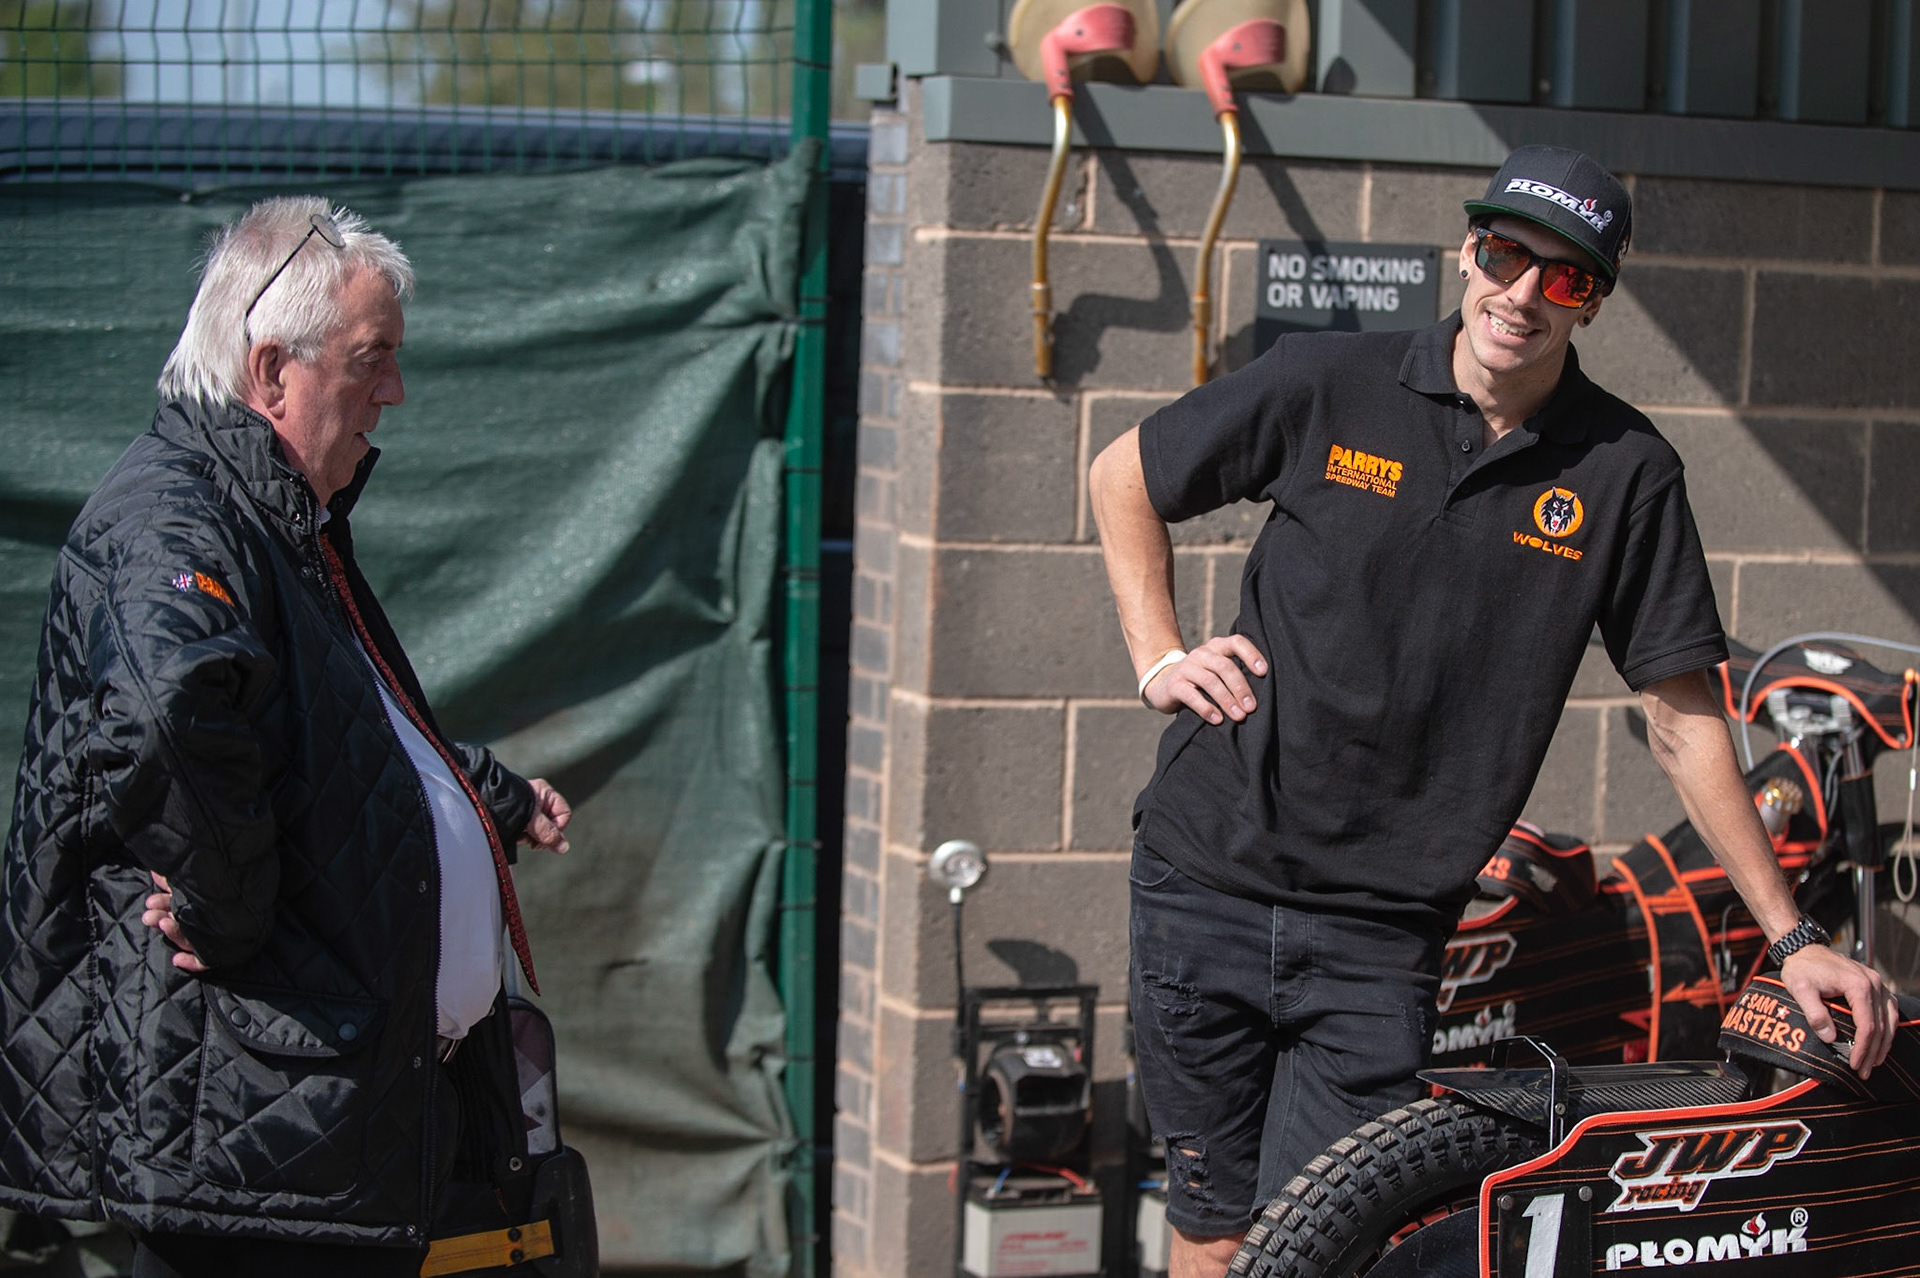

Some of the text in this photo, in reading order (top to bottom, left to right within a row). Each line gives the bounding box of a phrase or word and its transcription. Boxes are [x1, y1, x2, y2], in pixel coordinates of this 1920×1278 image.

[1268, 253, 1425, 284] NO SMOKING
[1267, 282, 1399, 312] OR VAPING
[1326, 464, 1397, 490] INTERNATIONAL
[1328, 444, 1403, 482] PARRYS
[1325, 472, 1396, 498] SPEEDWAY TEAM
[1513, 531, 1583, 561] WOLVES
[1747, 992, 1778, 1014] SAM
[1613, 1121, 1808, 1180] JWP
[1618, 1176, 1708, 1205] racing
[1522, 1193, 1565, 1278] 1
